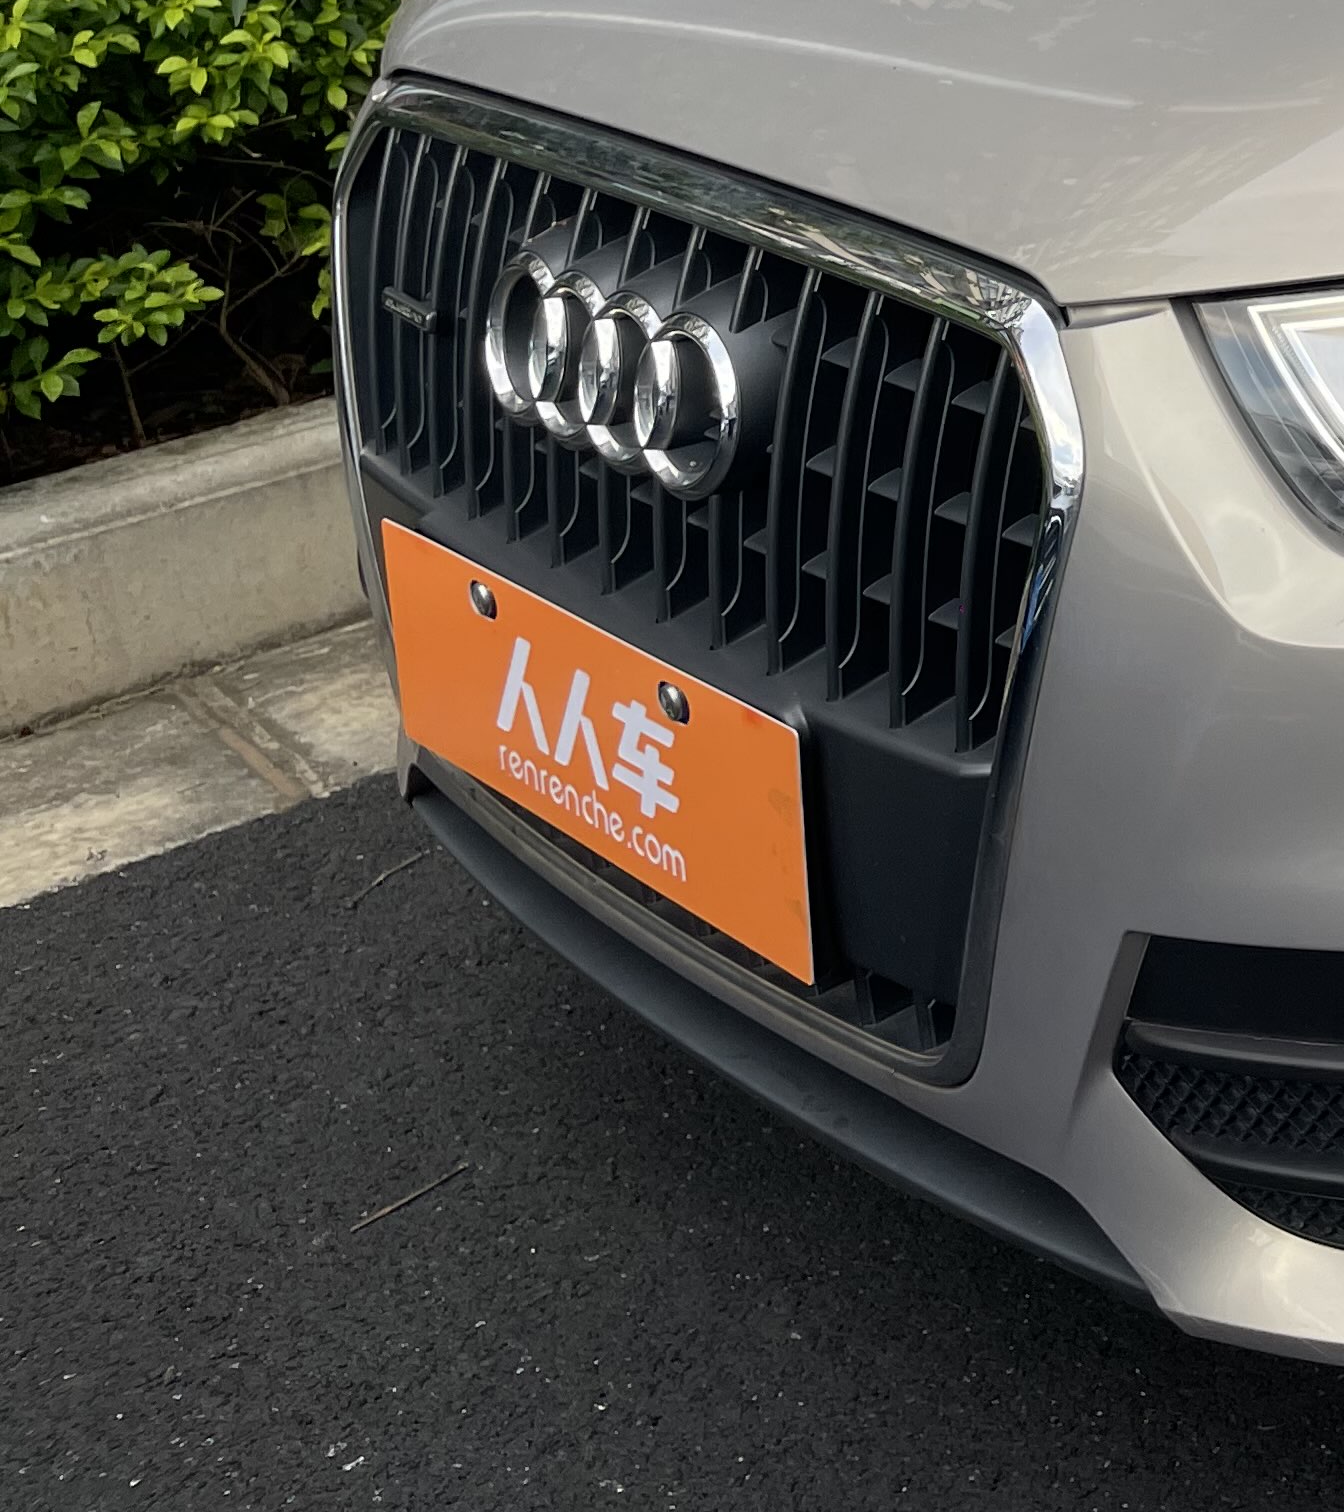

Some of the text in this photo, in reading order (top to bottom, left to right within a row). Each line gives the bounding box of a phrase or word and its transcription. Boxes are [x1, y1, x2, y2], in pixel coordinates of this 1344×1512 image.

[496, 636, 681, 819] 人人车
[499, 743, 688, 883] renrenche.com
